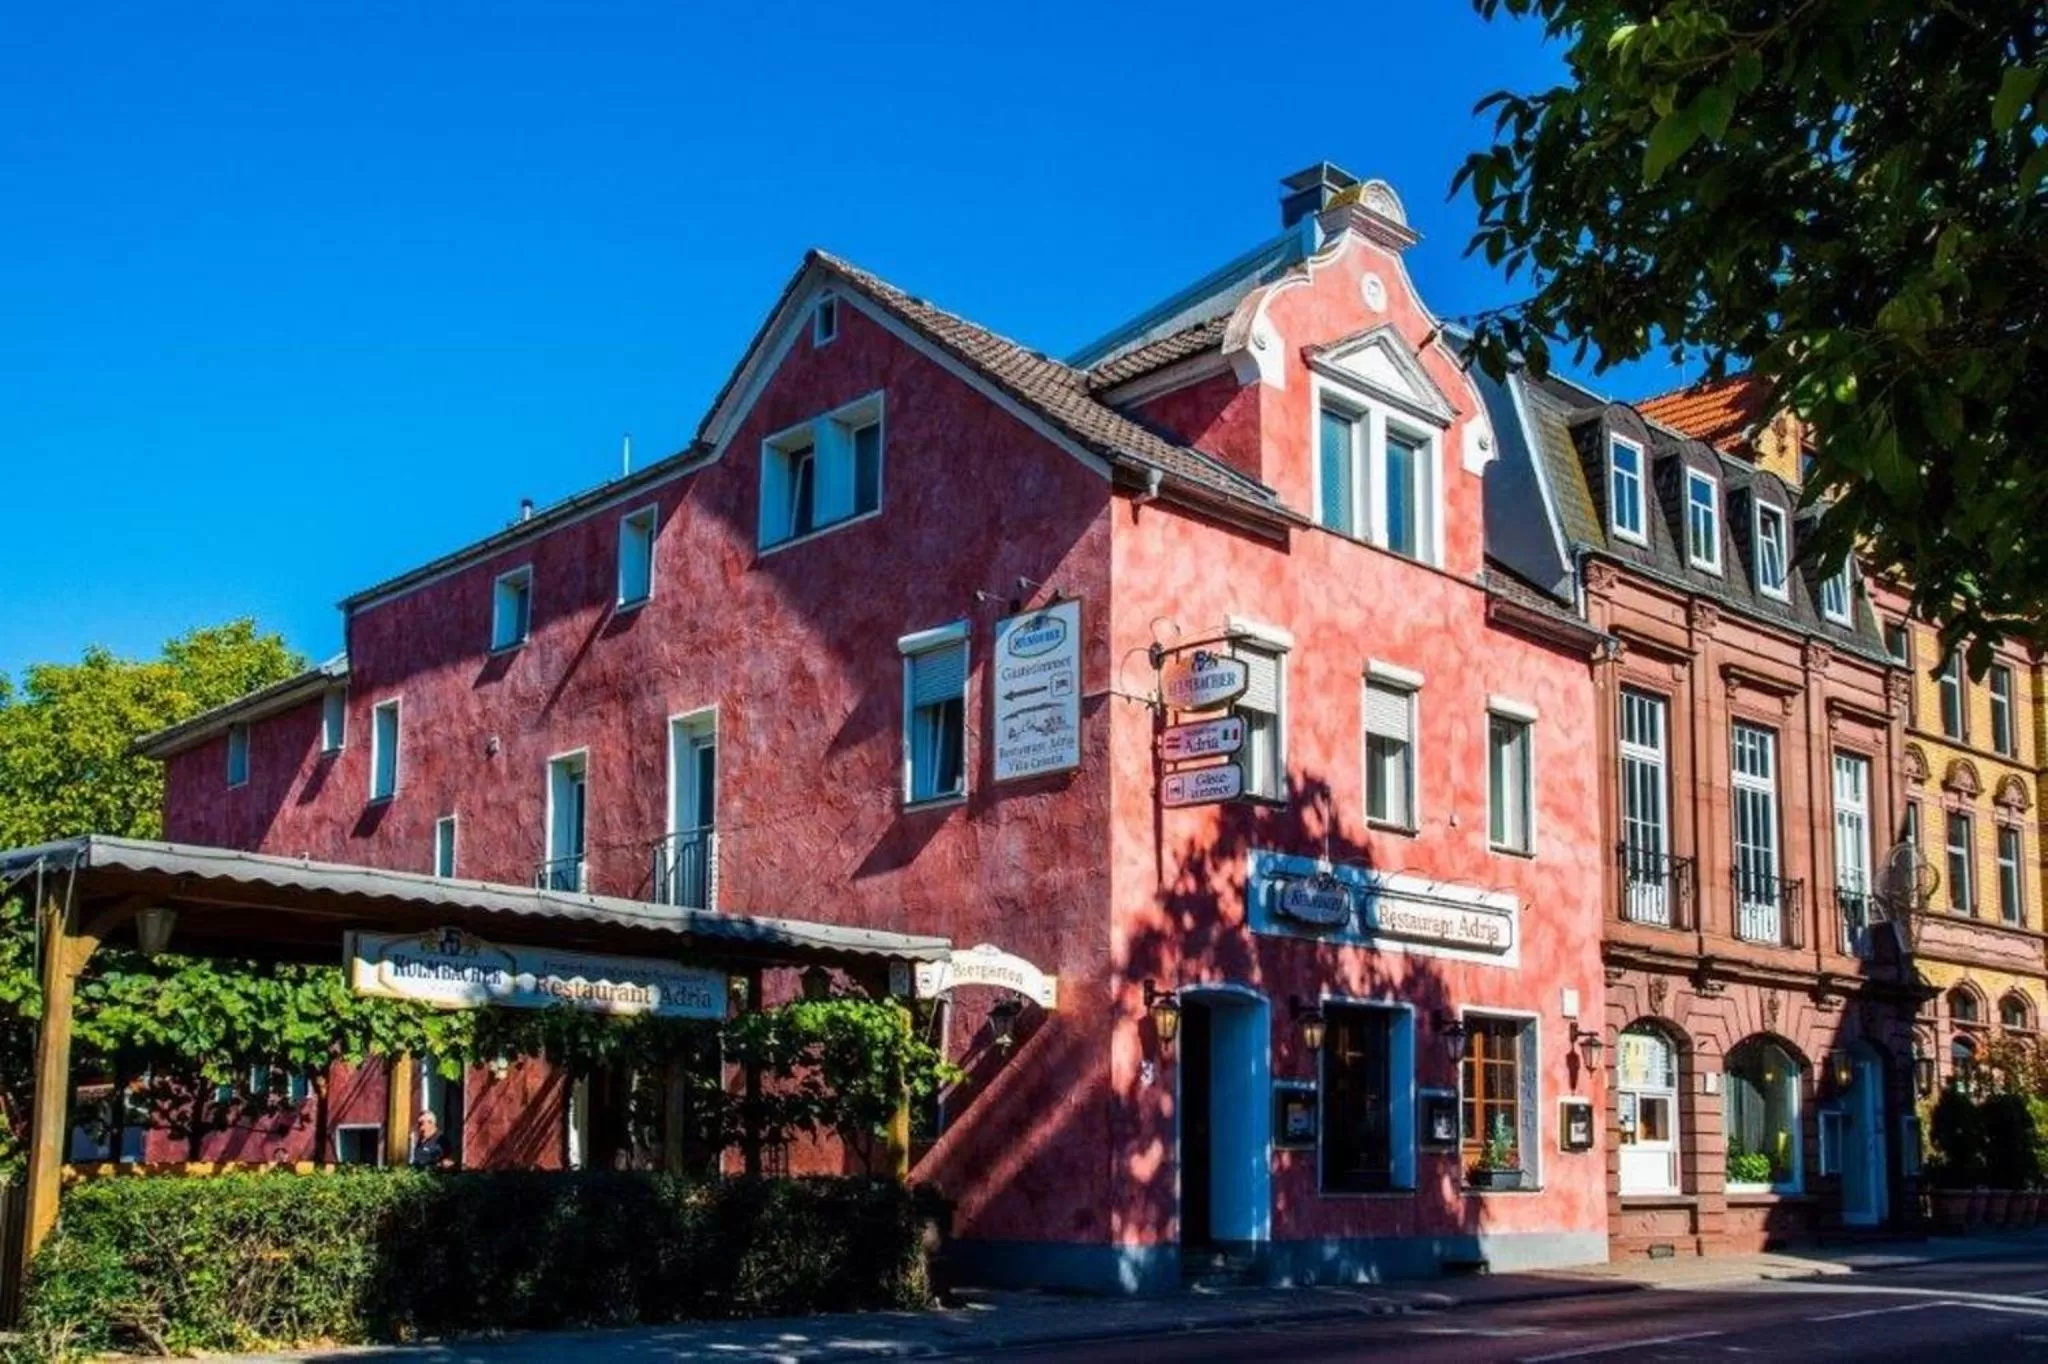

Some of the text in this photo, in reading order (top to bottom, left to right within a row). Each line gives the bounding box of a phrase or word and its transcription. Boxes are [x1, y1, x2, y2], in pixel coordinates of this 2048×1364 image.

[1185, 736, 1219, 753] Adria
[1379, 903, 1500, 941] Restaurant Adria
[393, 953, 501, 984] KULMBACHER
[534, 974, 653, 1005] Restaurant
